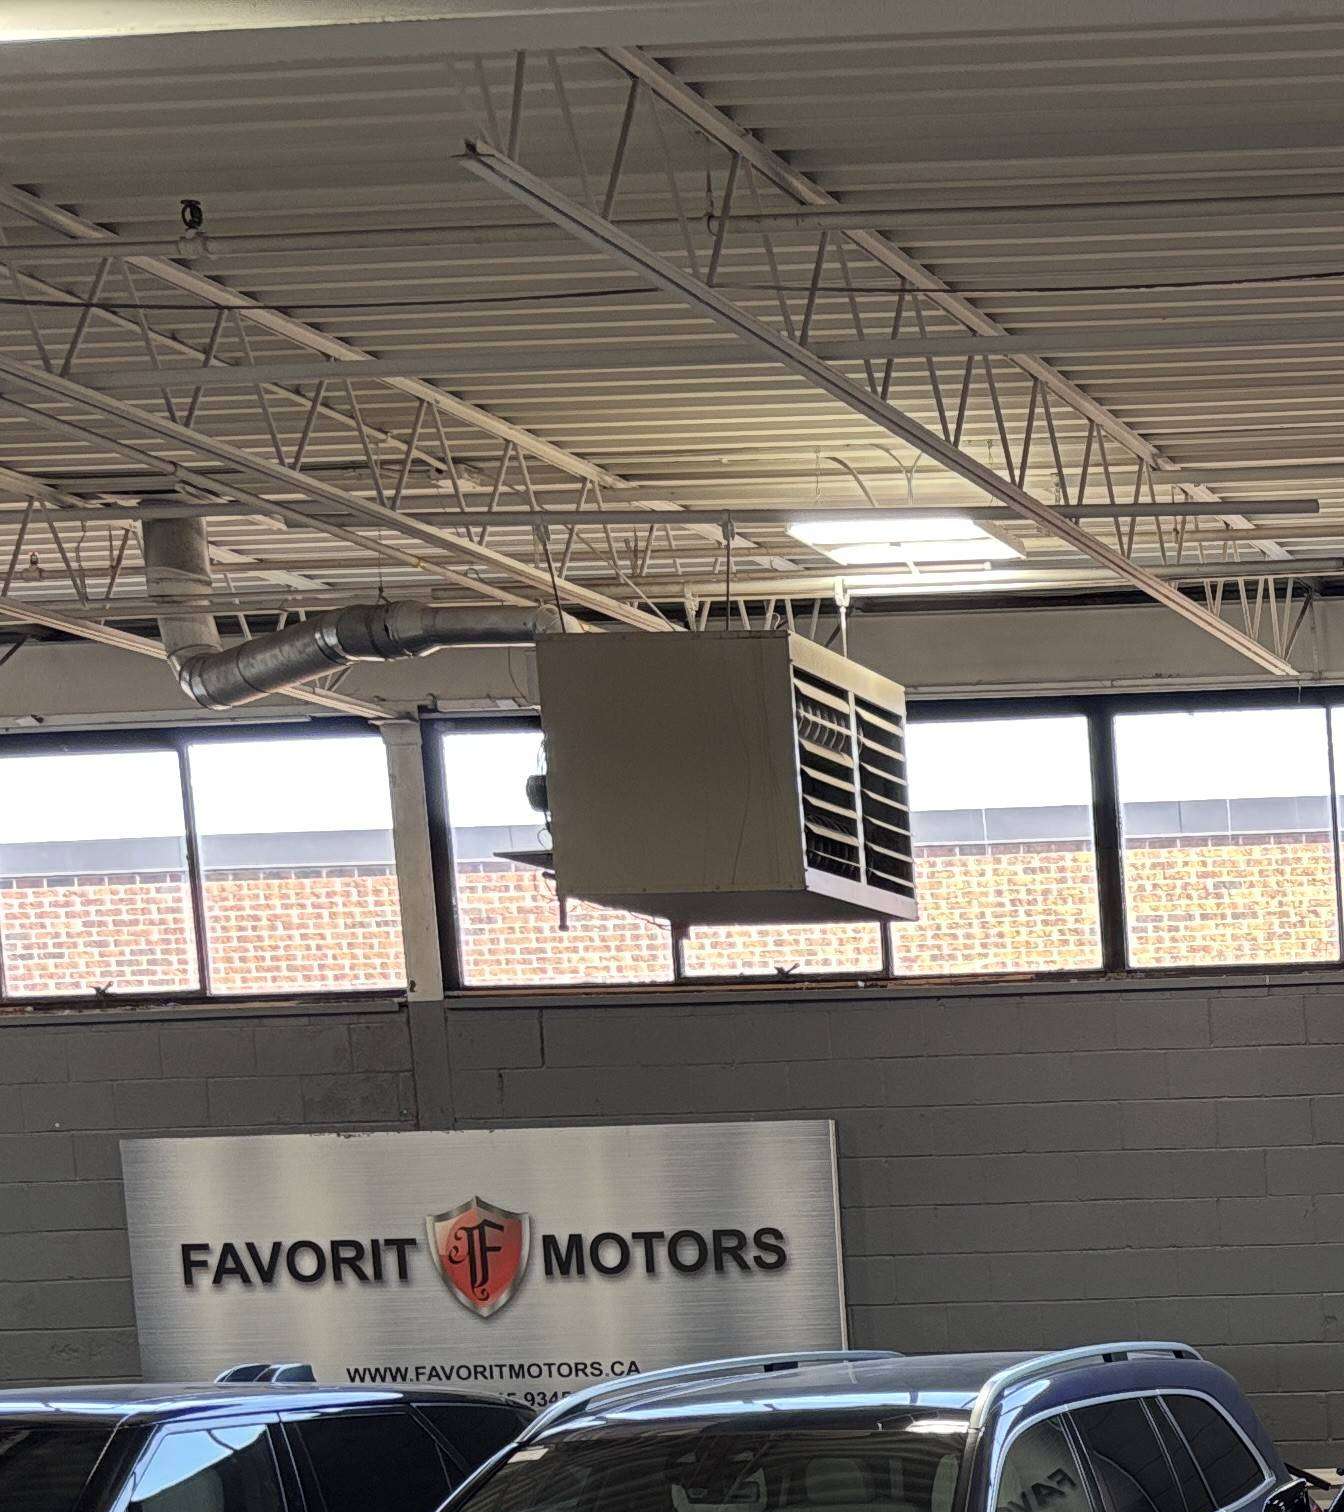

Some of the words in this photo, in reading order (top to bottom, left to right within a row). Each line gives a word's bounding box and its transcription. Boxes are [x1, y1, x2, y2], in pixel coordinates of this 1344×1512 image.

[181, 1238, 417, 1285] FAVORIT
[542, 1227, 787, 1276] MOTORS
[346, 1360, 641, 1383] WWW.FAVORITMOTORS.CA
